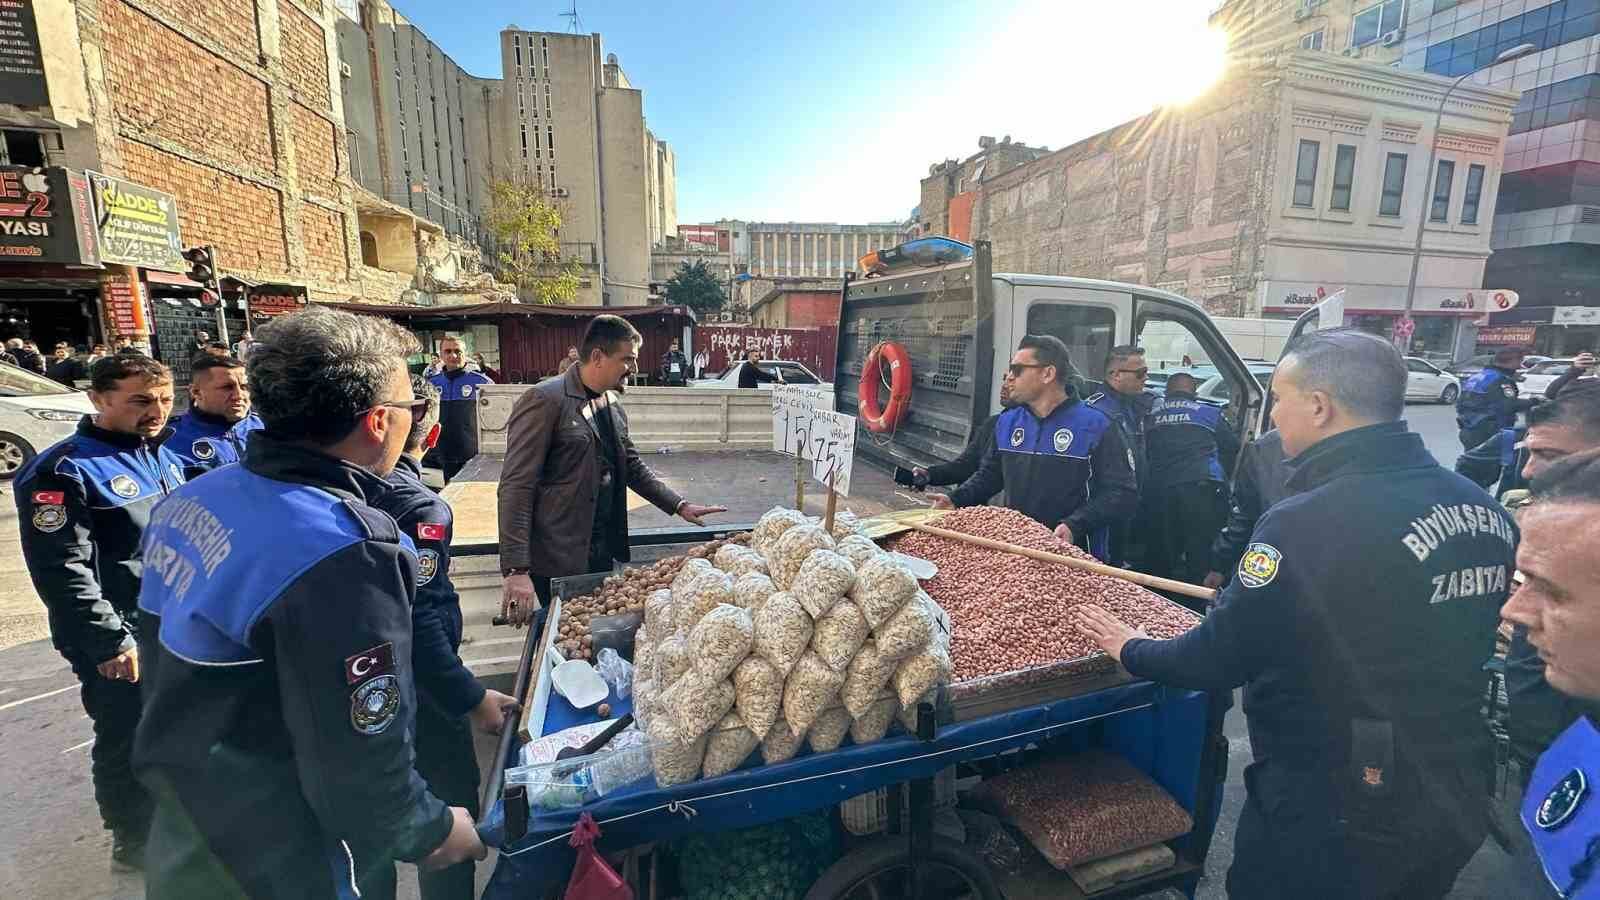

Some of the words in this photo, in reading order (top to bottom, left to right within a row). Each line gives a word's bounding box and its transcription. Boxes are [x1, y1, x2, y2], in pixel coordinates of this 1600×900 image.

[28, 192, 52, 217] 2
[103, 188, 158, 213] CADDE
[250, 295, 296, 307] CADDE
[711, 334, 740, 351] PARK
[814, 438, 839, 482] 75
[1429, 564, 1506, 604] ZABITA
